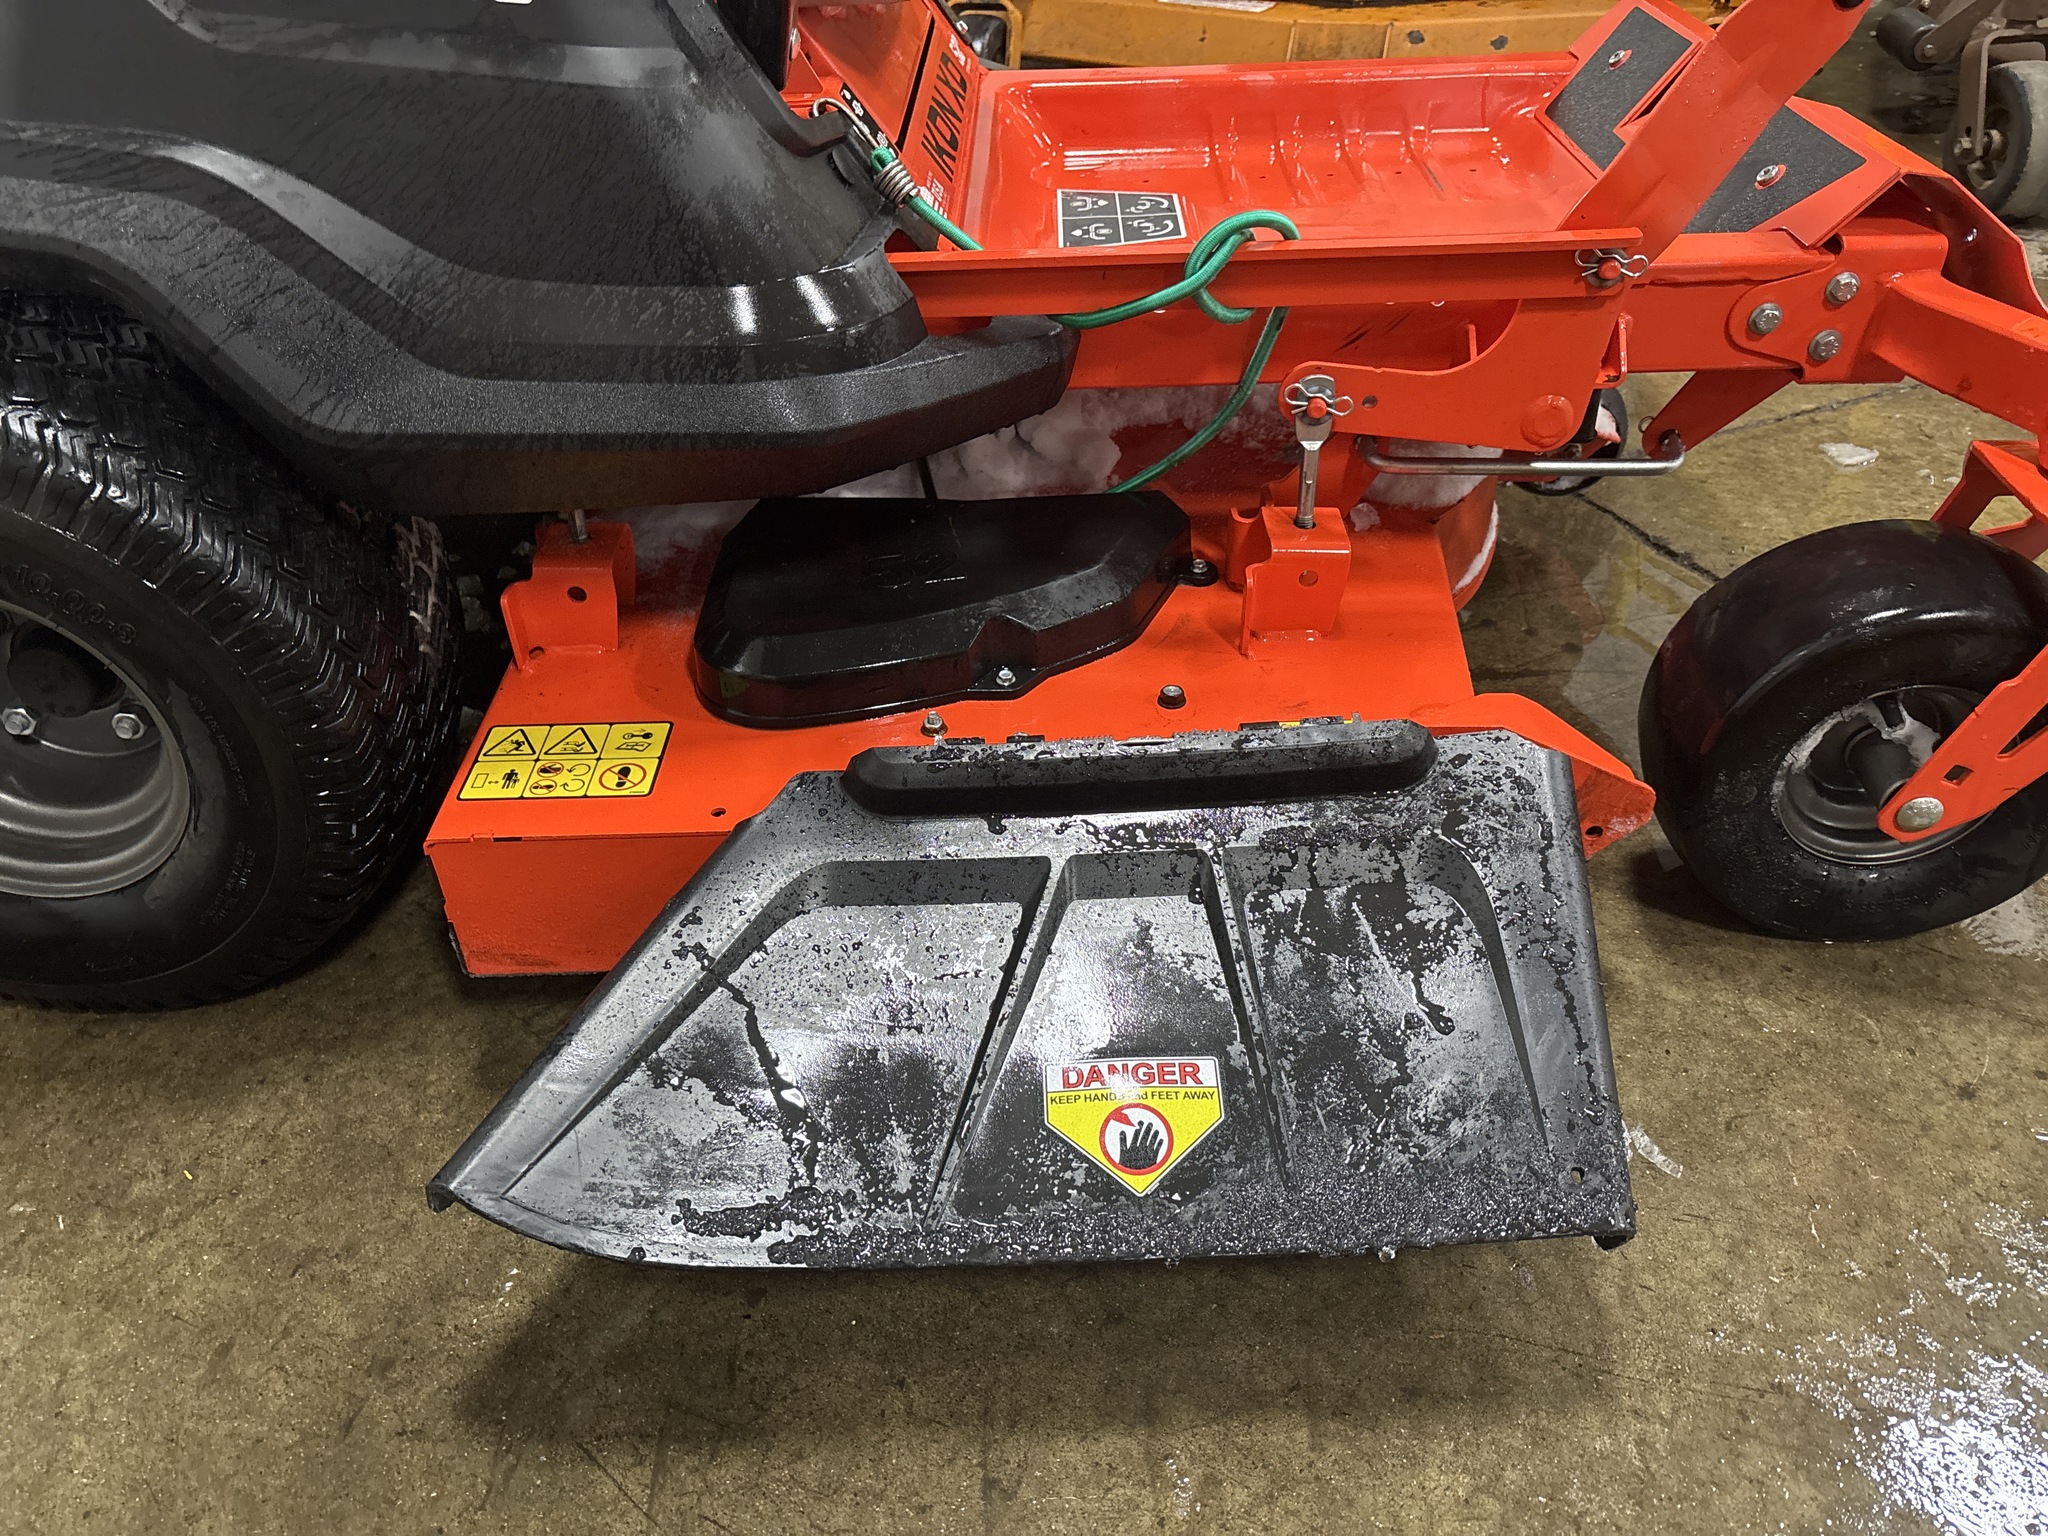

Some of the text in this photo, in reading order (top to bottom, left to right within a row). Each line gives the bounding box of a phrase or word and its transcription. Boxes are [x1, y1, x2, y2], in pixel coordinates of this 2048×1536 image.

[936, 52, 967, 113] XD
[921, 86, 962, 183] IKON
[1050, 1094, 1081, 1105] KEEP
[1151, 1090, 1180, 1101] FEET
[1183, 1089, 1216, 1101] AWAY
[1062, 1062, 1204, 1089] DANGER
